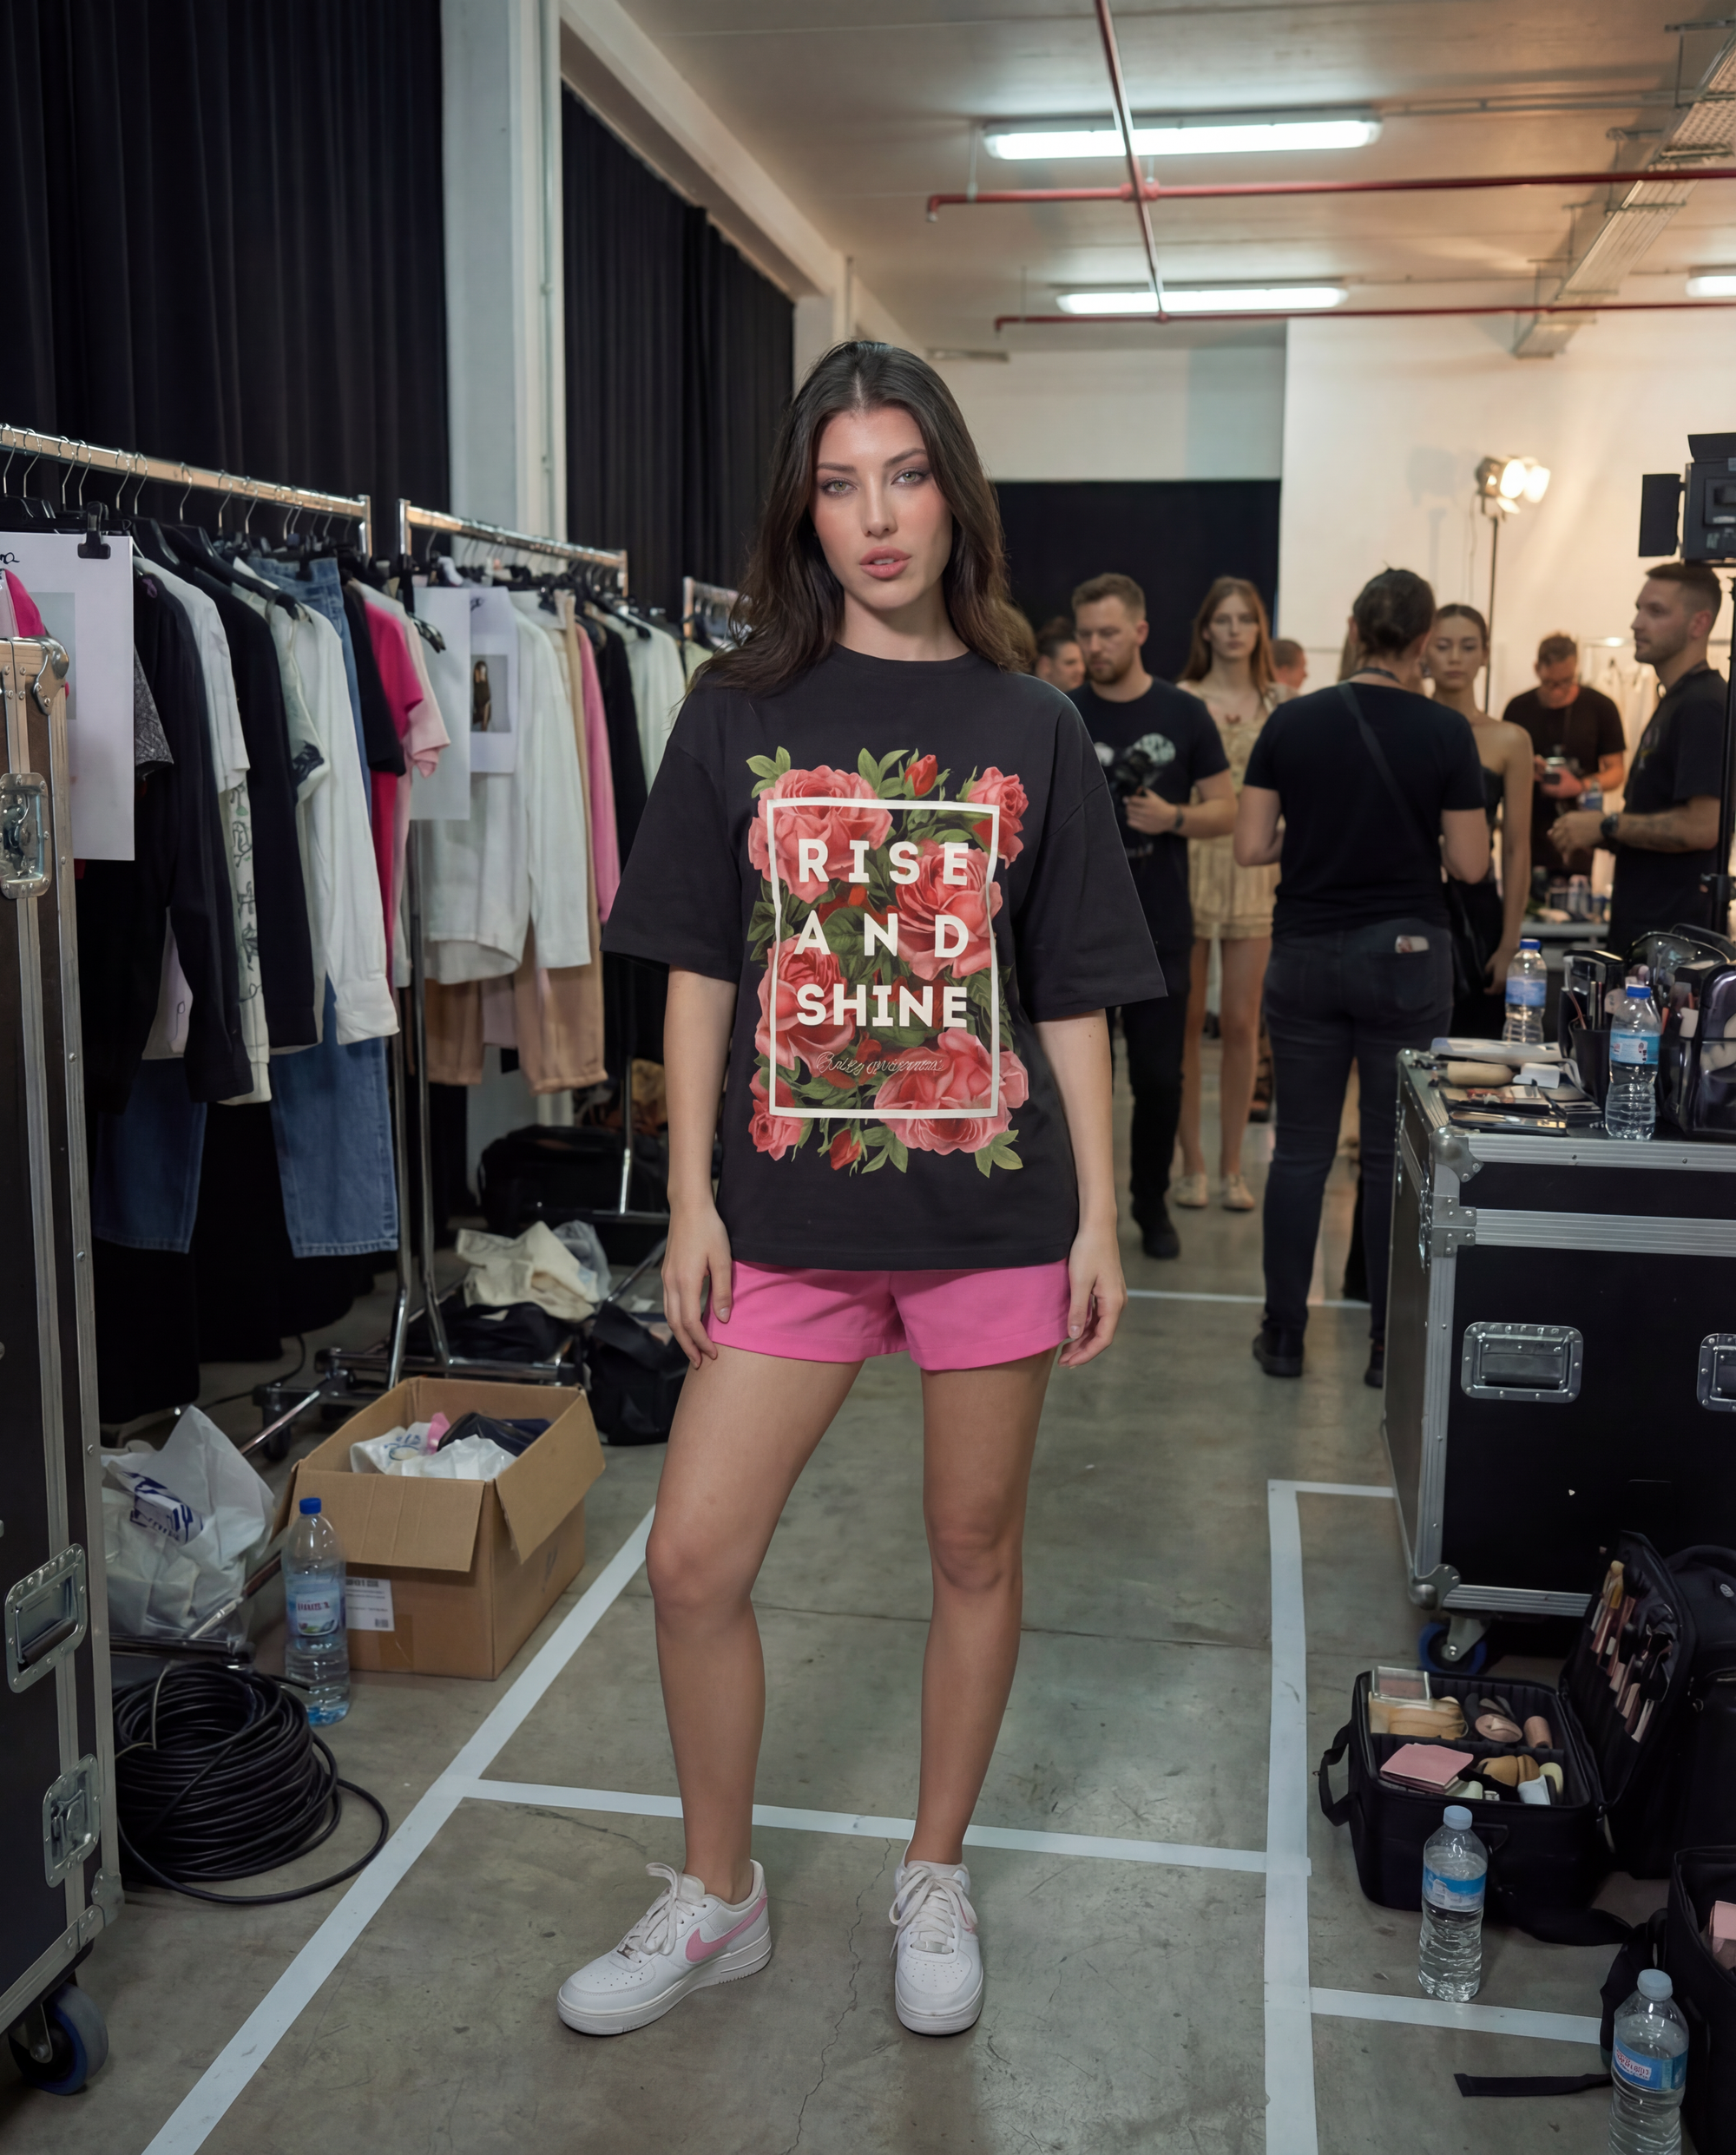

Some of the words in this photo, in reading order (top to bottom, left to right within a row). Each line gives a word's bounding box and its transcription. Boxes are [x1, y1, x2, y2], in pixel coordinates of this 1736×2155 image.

[798, 838, 970, 886] RISE
[793, 910, 970, 959] AND
[796, 983, 969, 1028] SHINE
